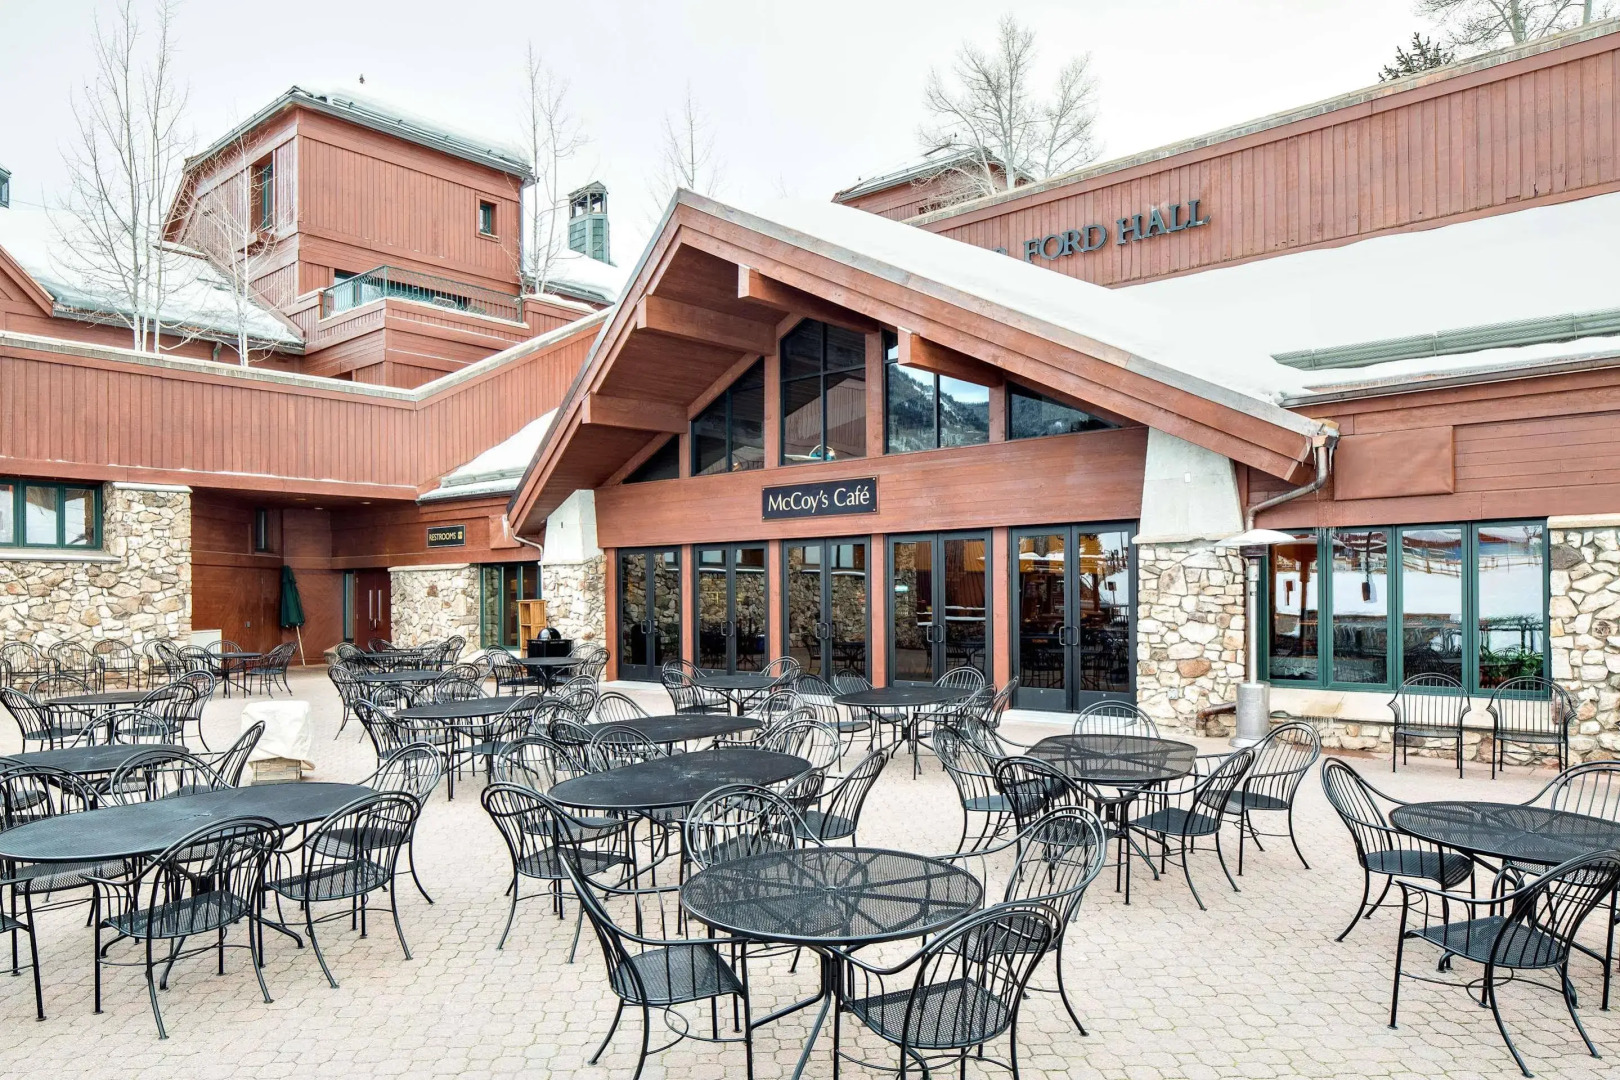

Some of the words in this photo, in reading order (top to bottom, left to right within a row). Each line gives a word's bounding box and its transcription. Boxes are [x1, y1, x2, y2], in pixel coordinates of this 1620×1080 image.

[1023, 224, 1107, 264] FORD
[1116, 199, 1211, 246] HALL
[767, 489, 829, 514] McCoy's
[833, 485, 870, 507] Café
[428, 532, 457, 542] RESTROOMS
